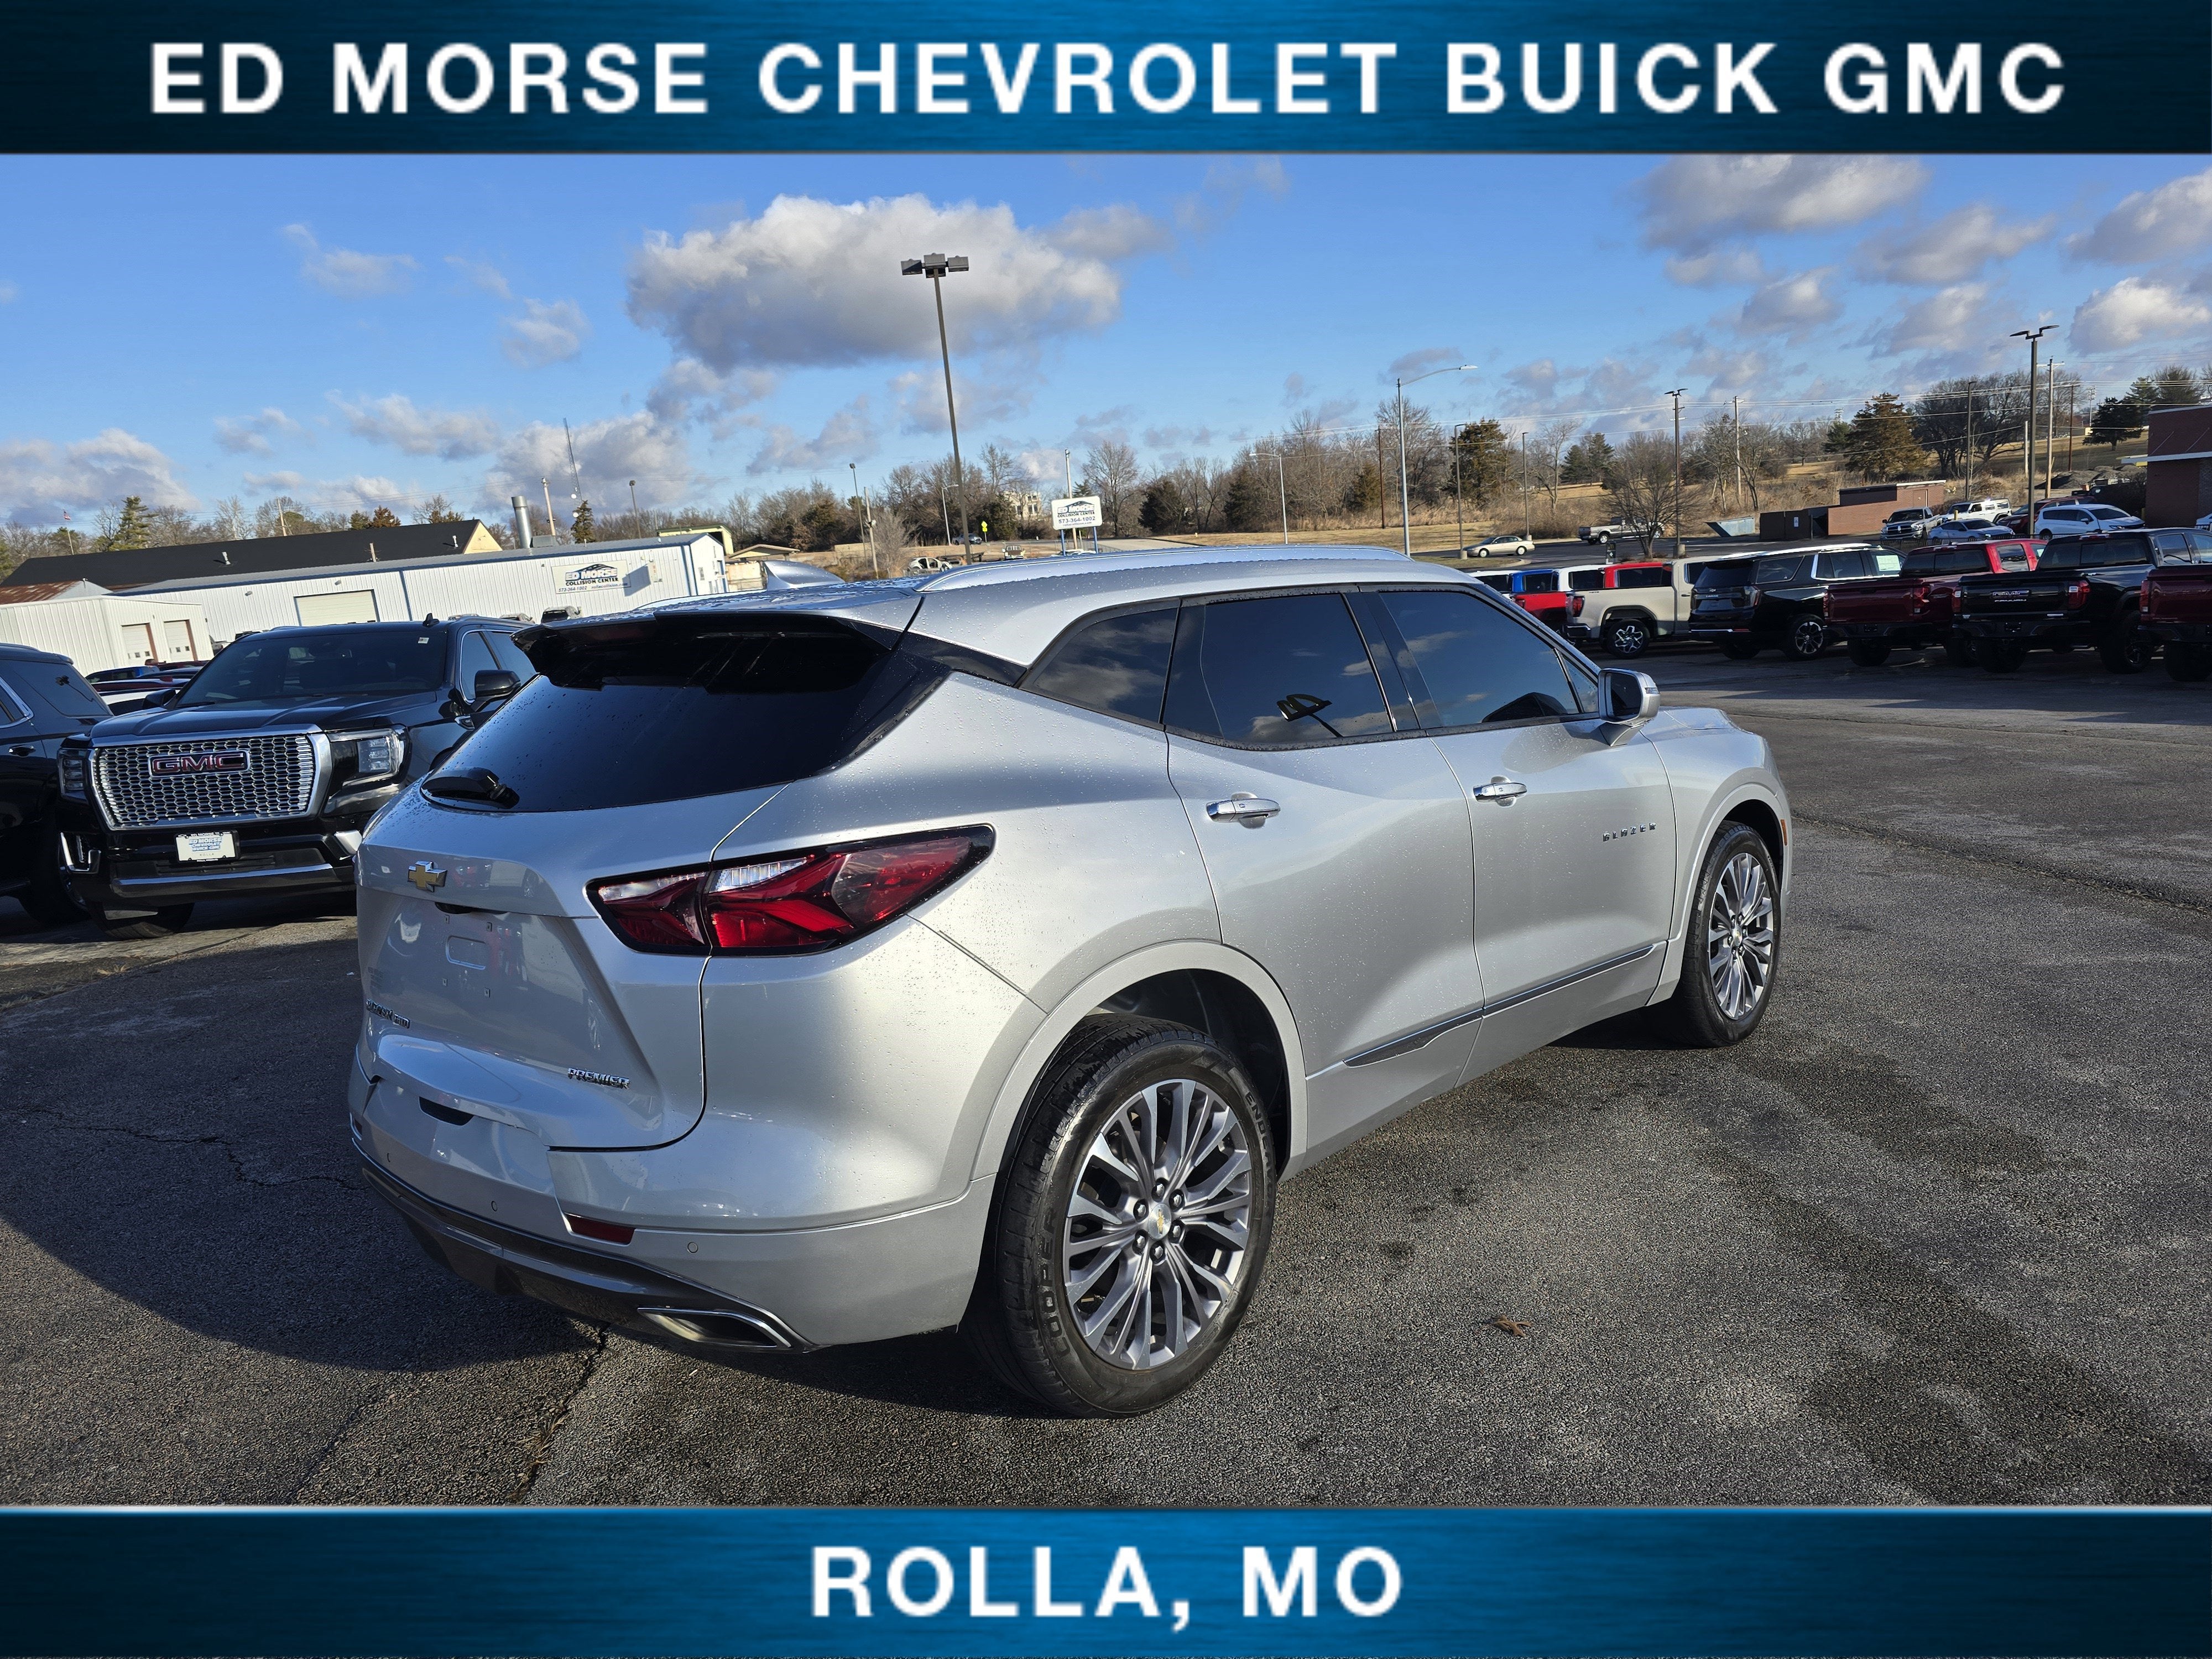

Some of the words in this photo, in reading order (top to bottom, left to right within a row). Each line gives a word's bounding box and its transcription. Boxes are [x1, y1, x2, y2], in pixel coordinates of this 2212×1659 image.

[566, 572, 580, 581] ED
[581, 568, 618, 580] MORSE
[153, 752, 245, 774] GMC
[1603, 822, 1656, 842] BLAZER
[567, 1067, 630, 1089] PREMIER
